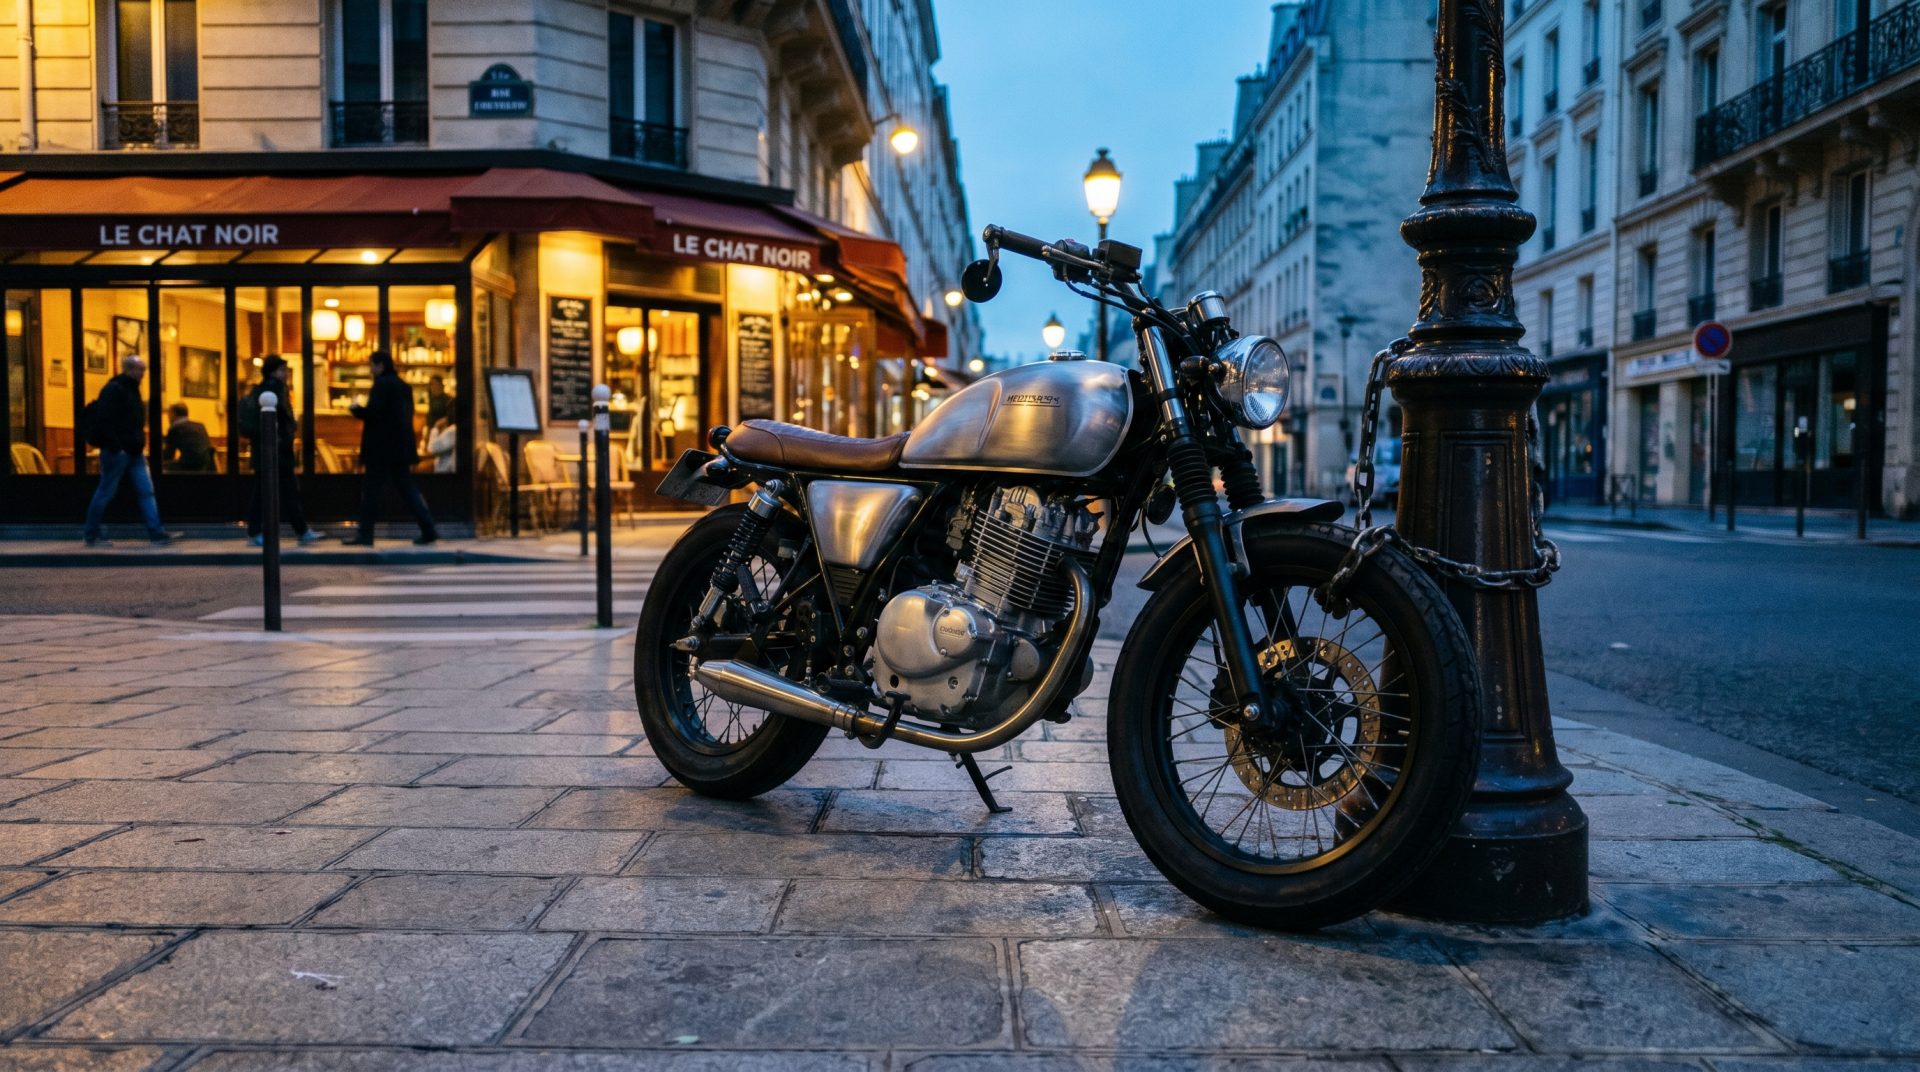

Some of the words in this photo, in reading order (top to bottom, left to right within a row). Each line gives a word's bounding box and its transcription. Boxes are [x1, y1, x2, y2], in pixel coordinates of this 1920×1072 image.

[100, 225, 130, 245] LE
[138, 224, 207, 245] CHAT
[214, 224, 279, 244] NOIR
[673, 233, 699, 255] LE
[704, 238, 759, 263] CHAT
[763, 245, 811, 269] NOIR
